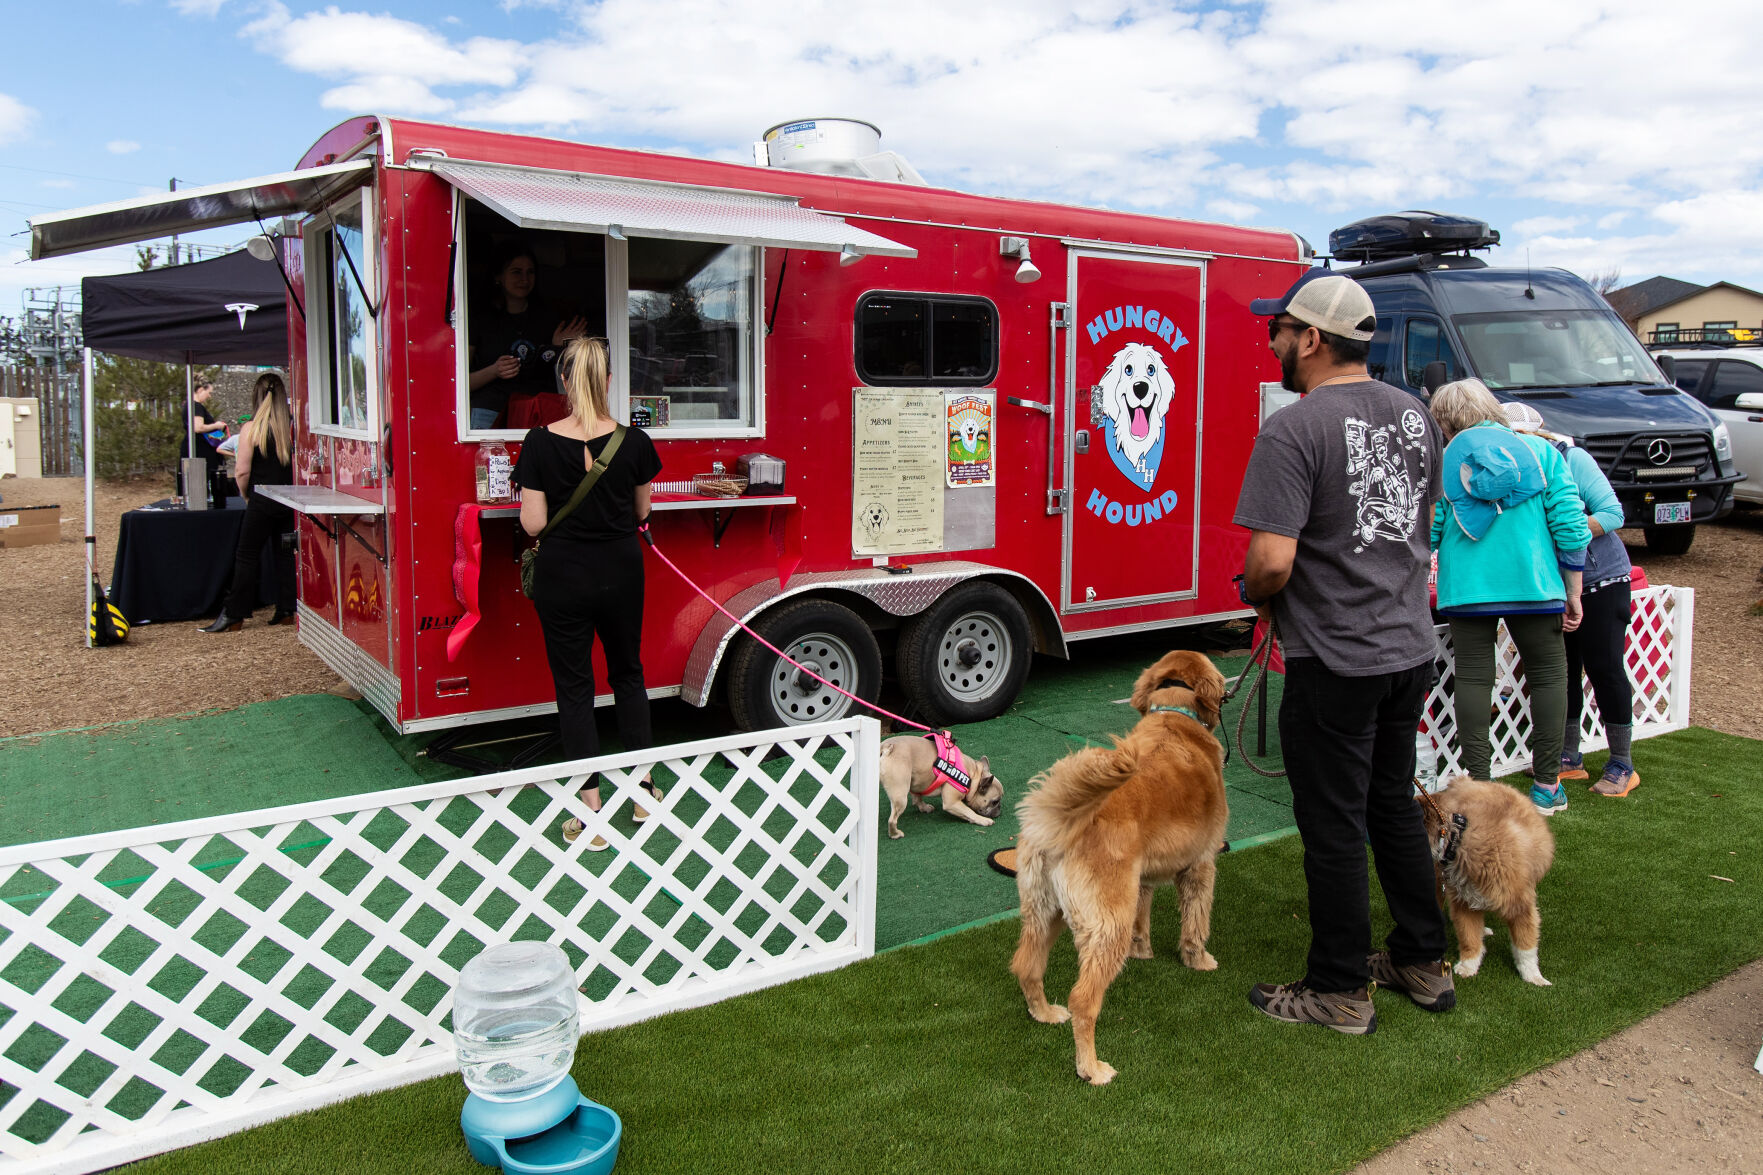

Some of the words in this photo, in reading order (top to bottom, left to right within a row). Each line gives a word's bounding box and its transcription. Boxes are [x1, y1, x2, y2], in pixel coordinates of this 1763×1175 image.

[1086, 305, 1190, 353] HUNGRY
[951, 401, 970, 415] WOOF
[971, 402, 988, 415] FEST
[1085, 487, 1179, 527] HOUND
[419, 615, 463, 631] BLAZ
[937, 759, 947, 770] DO
[946, 765, 960, 778] NOT
[959, 773, 970, 785] PET
